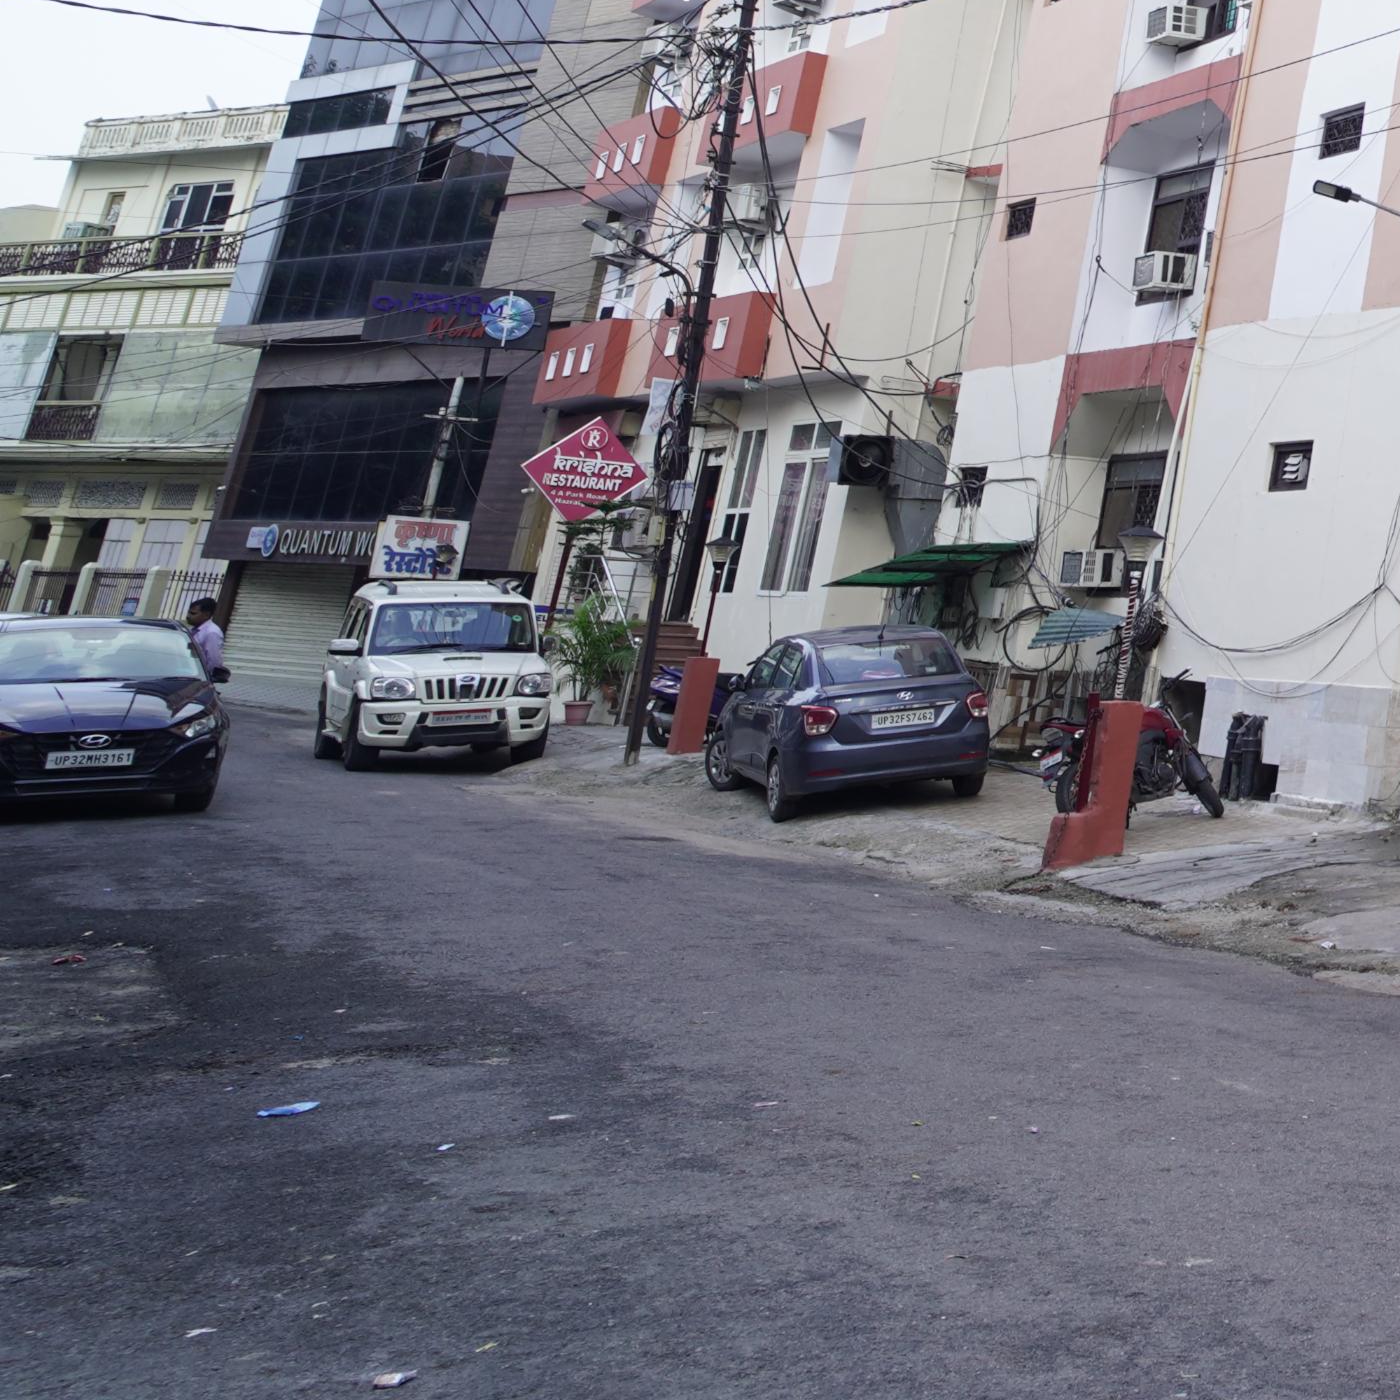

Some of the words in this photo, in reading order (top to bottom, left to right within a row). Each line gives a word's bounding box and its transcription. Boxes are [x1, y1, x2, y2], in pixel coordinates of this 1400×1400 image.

[372, 295, 503, 318] QUANTUM
[553, 447, 636, 478] krishna
[542, 472, 623, 492] RESTAURANT
[279, 528, 353, 556] QUANTUM
[877, 711, 933, 725] UP32FS7462
[55, 753, 131, 765] UP32MH3161
